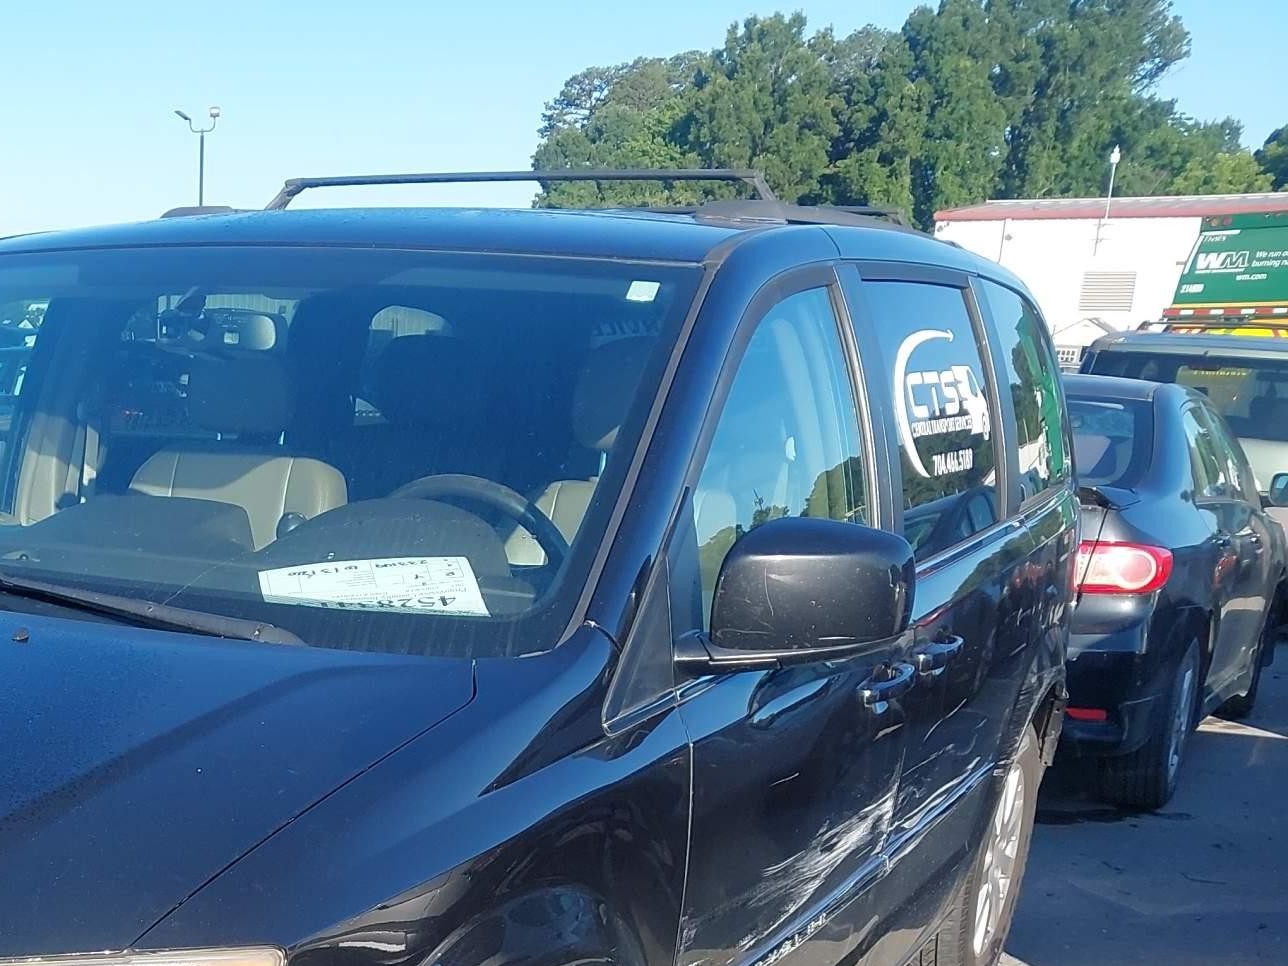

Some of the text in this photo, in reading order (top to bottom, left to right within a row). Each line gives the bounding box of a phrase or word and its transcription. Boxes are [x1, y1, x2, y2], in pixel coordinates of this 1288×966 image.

[1256, 250, 1268, 258] We
[1196, 251, 1249, 269] WM
[1251, 259, 1281, 268] burning
[1235, 273, 1267, 281] wm.com
[906, 371, 960, 418] CTS
